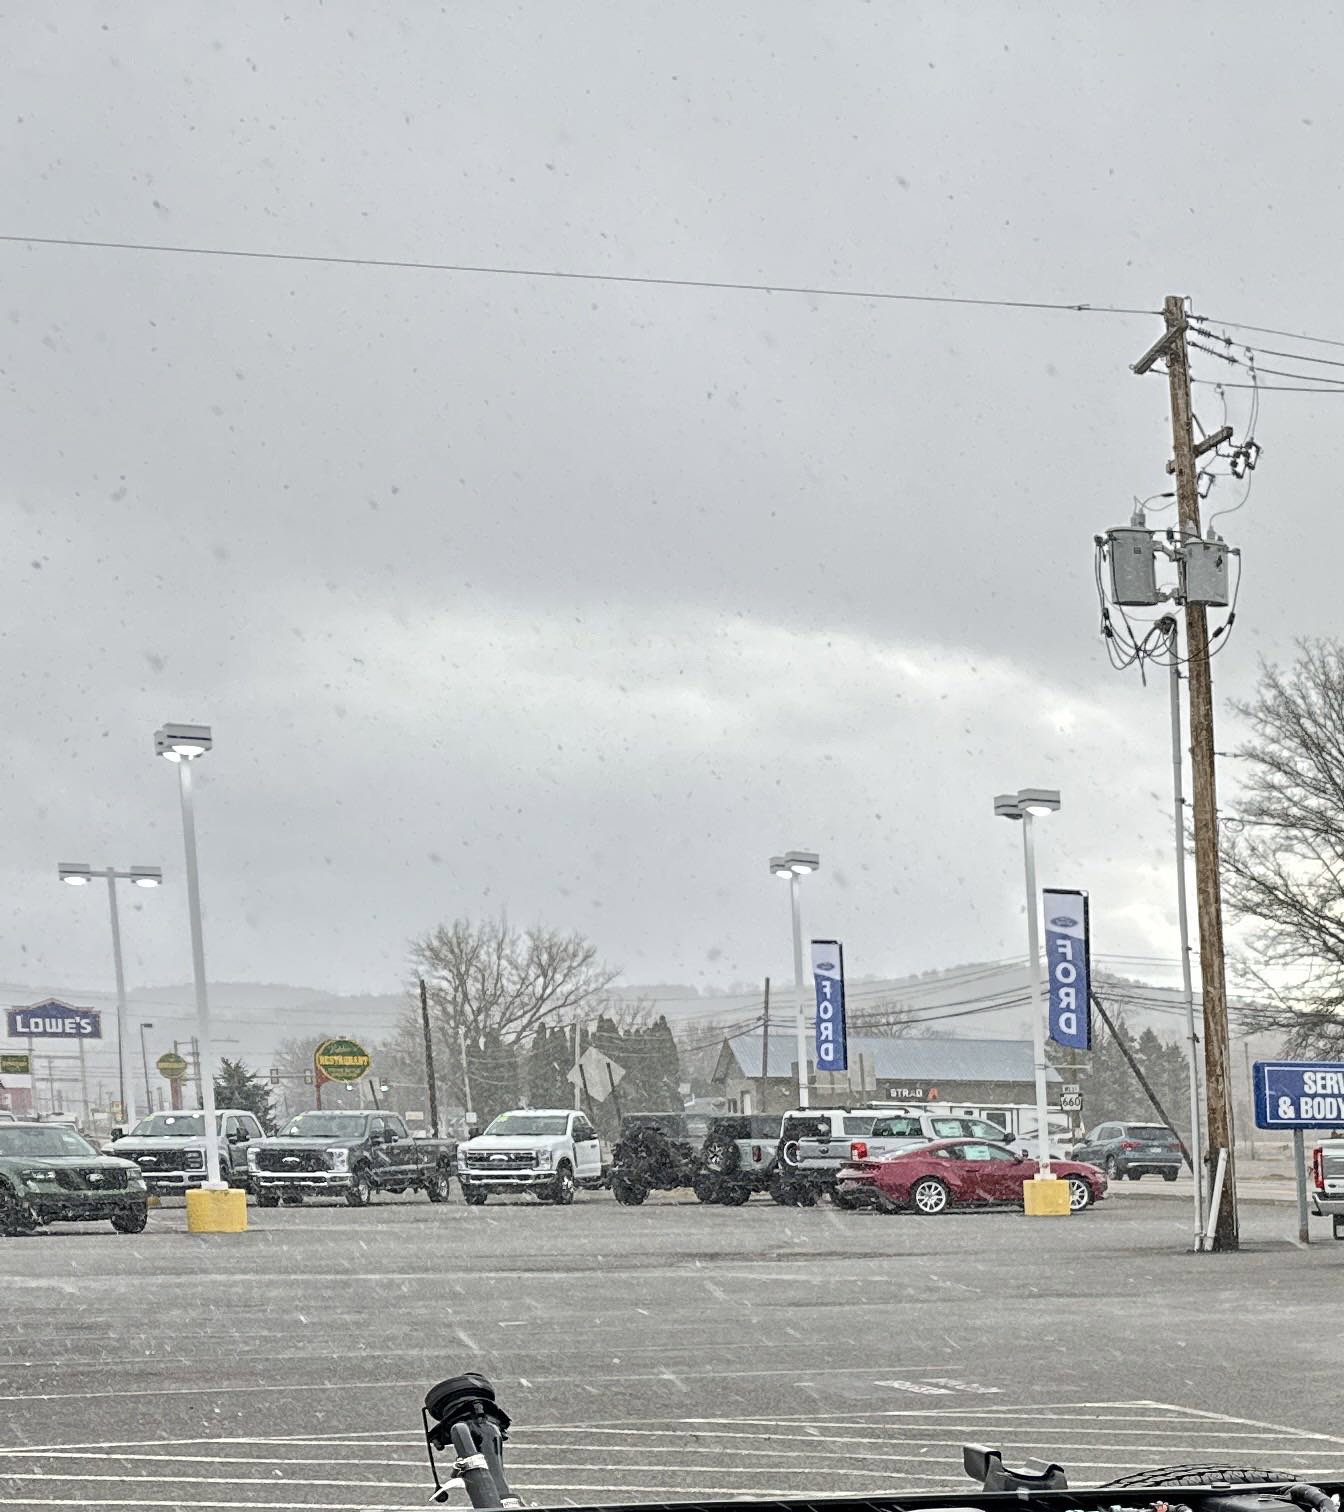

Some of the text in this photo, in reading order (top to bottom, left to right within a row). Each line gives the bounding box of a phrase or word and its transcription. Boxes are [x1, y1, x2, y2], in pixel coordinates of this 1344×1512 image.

[15, 1015, 92, 1033] LOWE'S
[1062, 1096, 1080, 1106] 660
[1278, 1096, 1295, 1119] &
